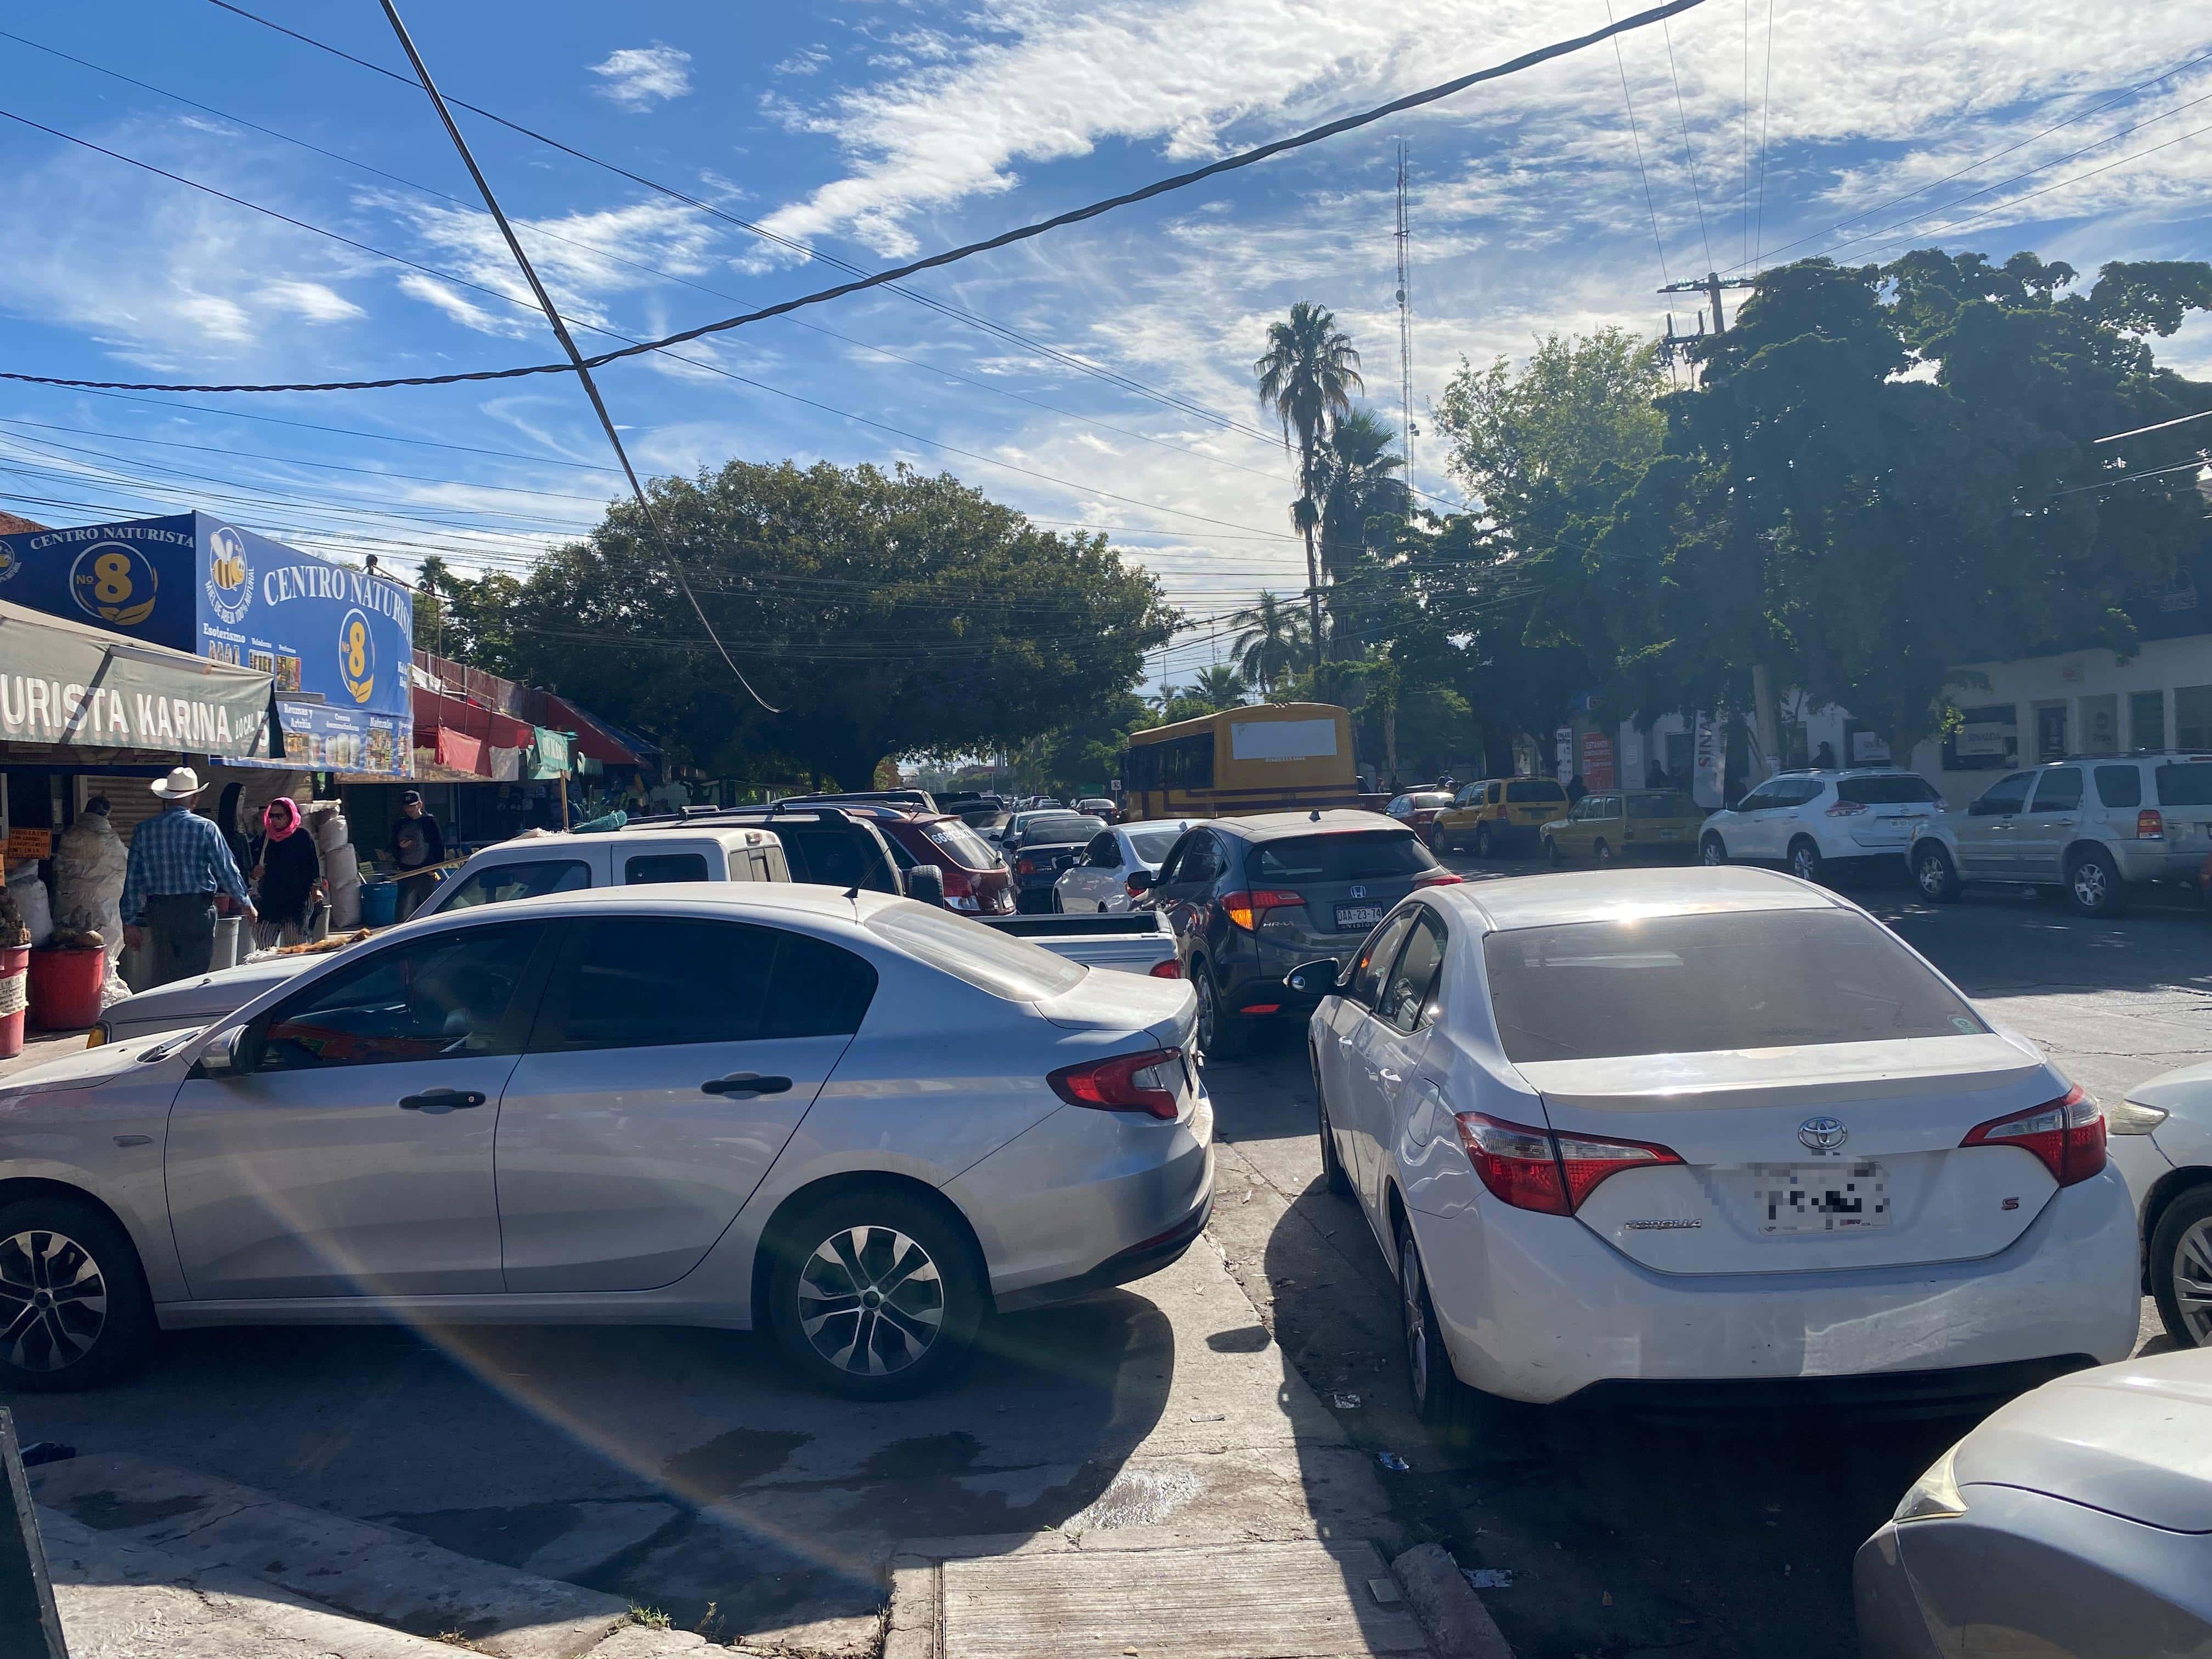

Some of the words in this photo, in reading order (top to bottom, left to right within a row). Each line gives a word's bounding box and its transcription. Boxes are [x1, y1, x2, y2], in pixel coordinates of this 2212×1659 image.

[30, 528, 98, 550] CENTRO
[104, 527, 194, 548] NATURISTA
[94, 553, 133, 603] 8
[205, 580, 216, 607] MIEL
[214, 600, 222, 617] DE
[244, 566, 255, 607] NATURAL
[263, 565, 345, 606] CENTRO
[202, 622, 246, 644] Esoterismo
[349, 621, 365, 678] 8
[1, 673, 130, 733] URISTA
[137, 693, 233, 743] KARINA
[235, 713, 255, 740] LOCAL
[257, 710, 269, 747] 5
[1338, 909, 1381, 921] DAA-23-74
[1624, 1219, 1702, 1230] COROLLA
